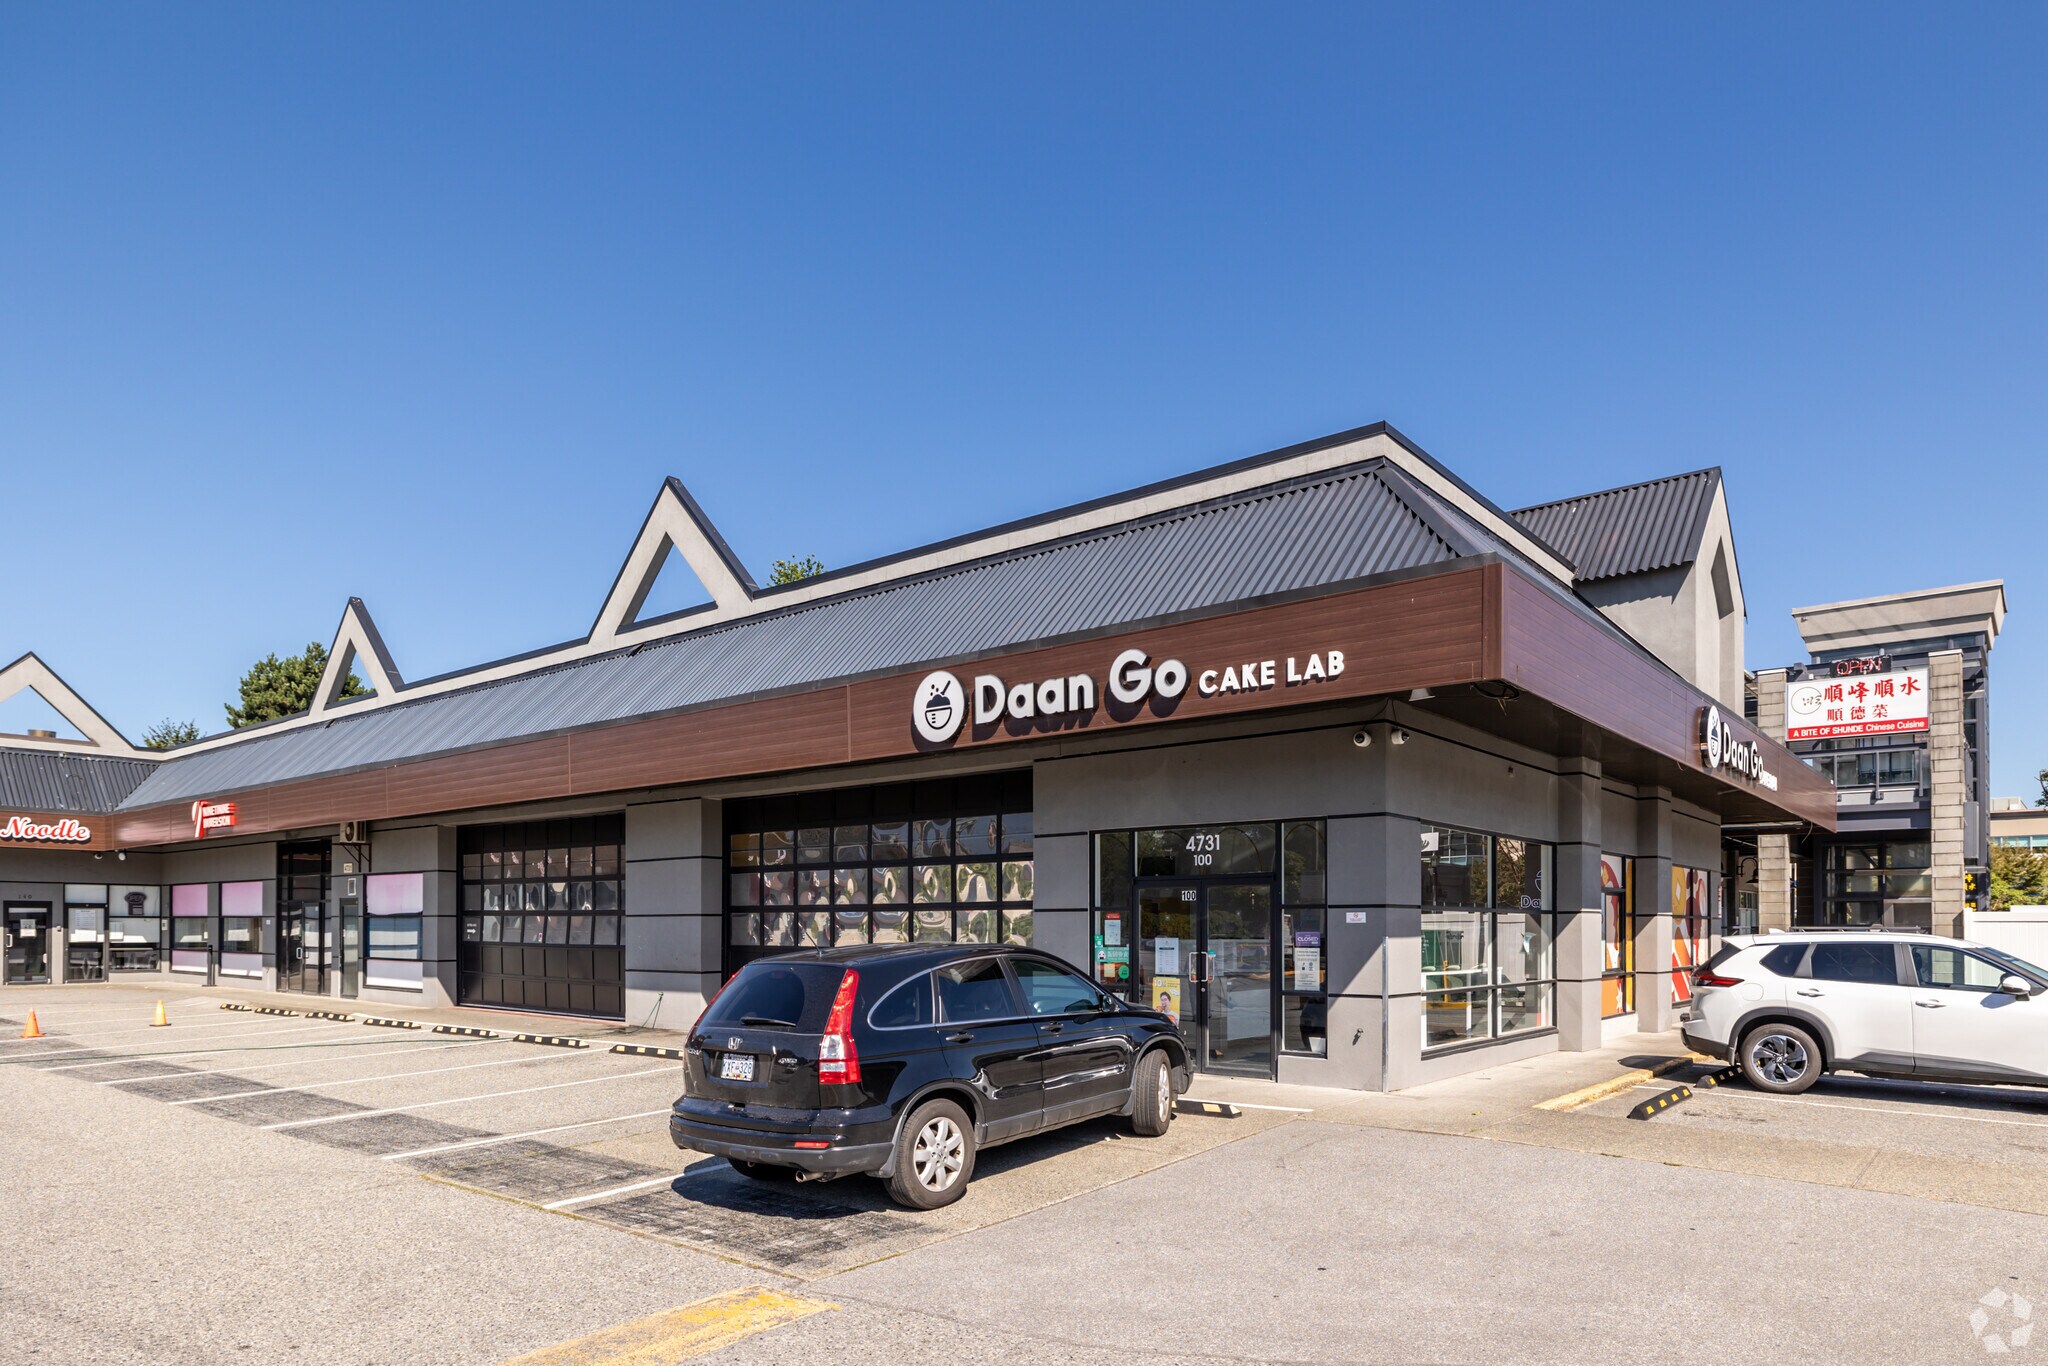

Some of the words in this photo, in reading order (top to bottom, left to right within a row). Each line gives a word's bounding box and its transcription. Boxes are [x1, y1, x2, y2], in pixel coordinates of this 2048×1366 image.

[1836, 657, 1882, 675] OPEN
[974, 673, 1095, 725] Daan
[1109, 648, 1188, 704] Go
[1199, 659, 1275, 694] CAKE
[1287, 650, 1345, 682] LAB
[1793, 729, 1800, 738] A
[1801, 728, 1818, 737] BITE
[1820, 727, 1831, 736] OF
[1832, 725, 1864, 735] SHUNDE
[1865, 721, 1895, 731] Chinese
[1896, 719, 1925, 730] Cuisine
[1723, 722, 1749, 775] Daan
[1750, 740, 1764, 781] Go
[0, 816, 91, 841] Noodle
[1185, 834, 1221, 852] 4731
[1193, 853, 1212, 866] 100
[1182, 891, 1197, 901] 100
